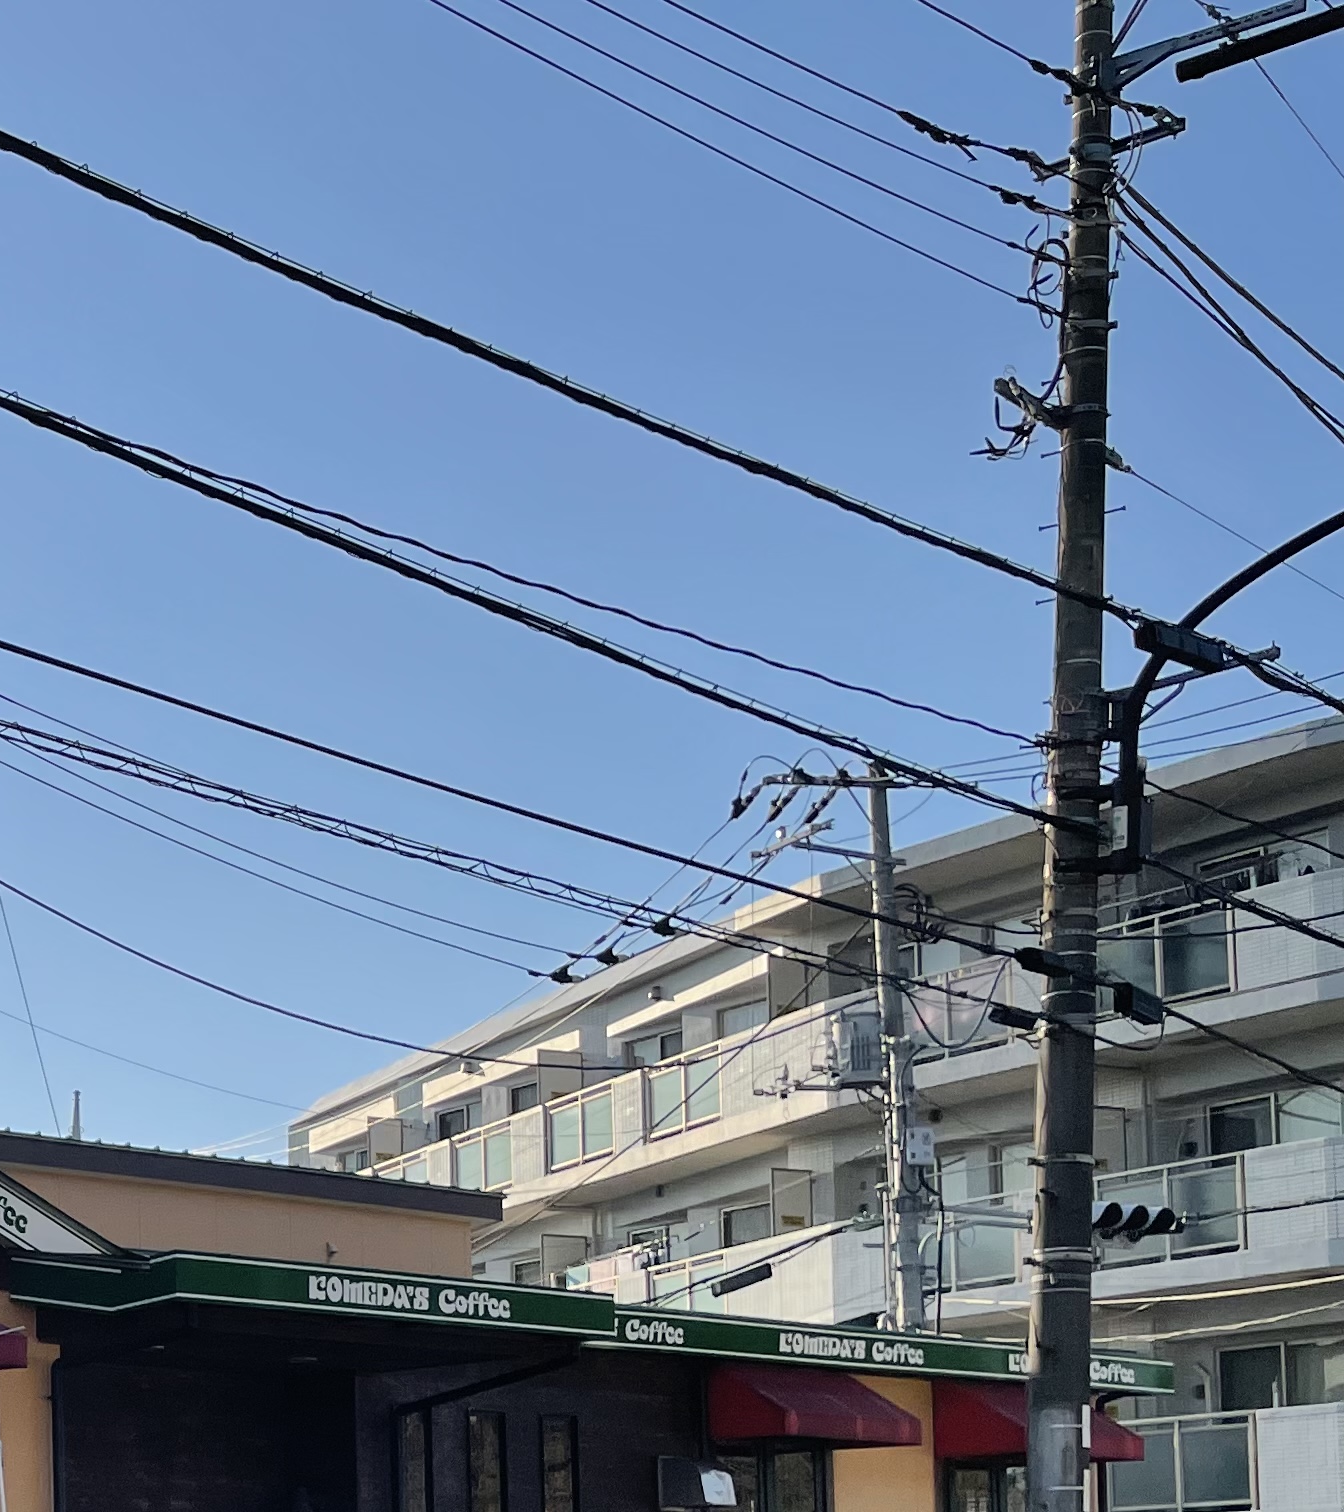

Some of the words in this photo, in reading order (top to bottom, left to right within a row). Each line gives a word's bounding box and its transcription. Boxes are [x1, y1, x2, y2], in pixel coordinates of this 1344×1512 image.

[308, 1274, 430, 1312] KOMEDA'S
[437, 1287, 511, 1319] Coffee
[624, 1318, 685, 1345] Coffee
[871, 1340, 924, 1366] Coffee
